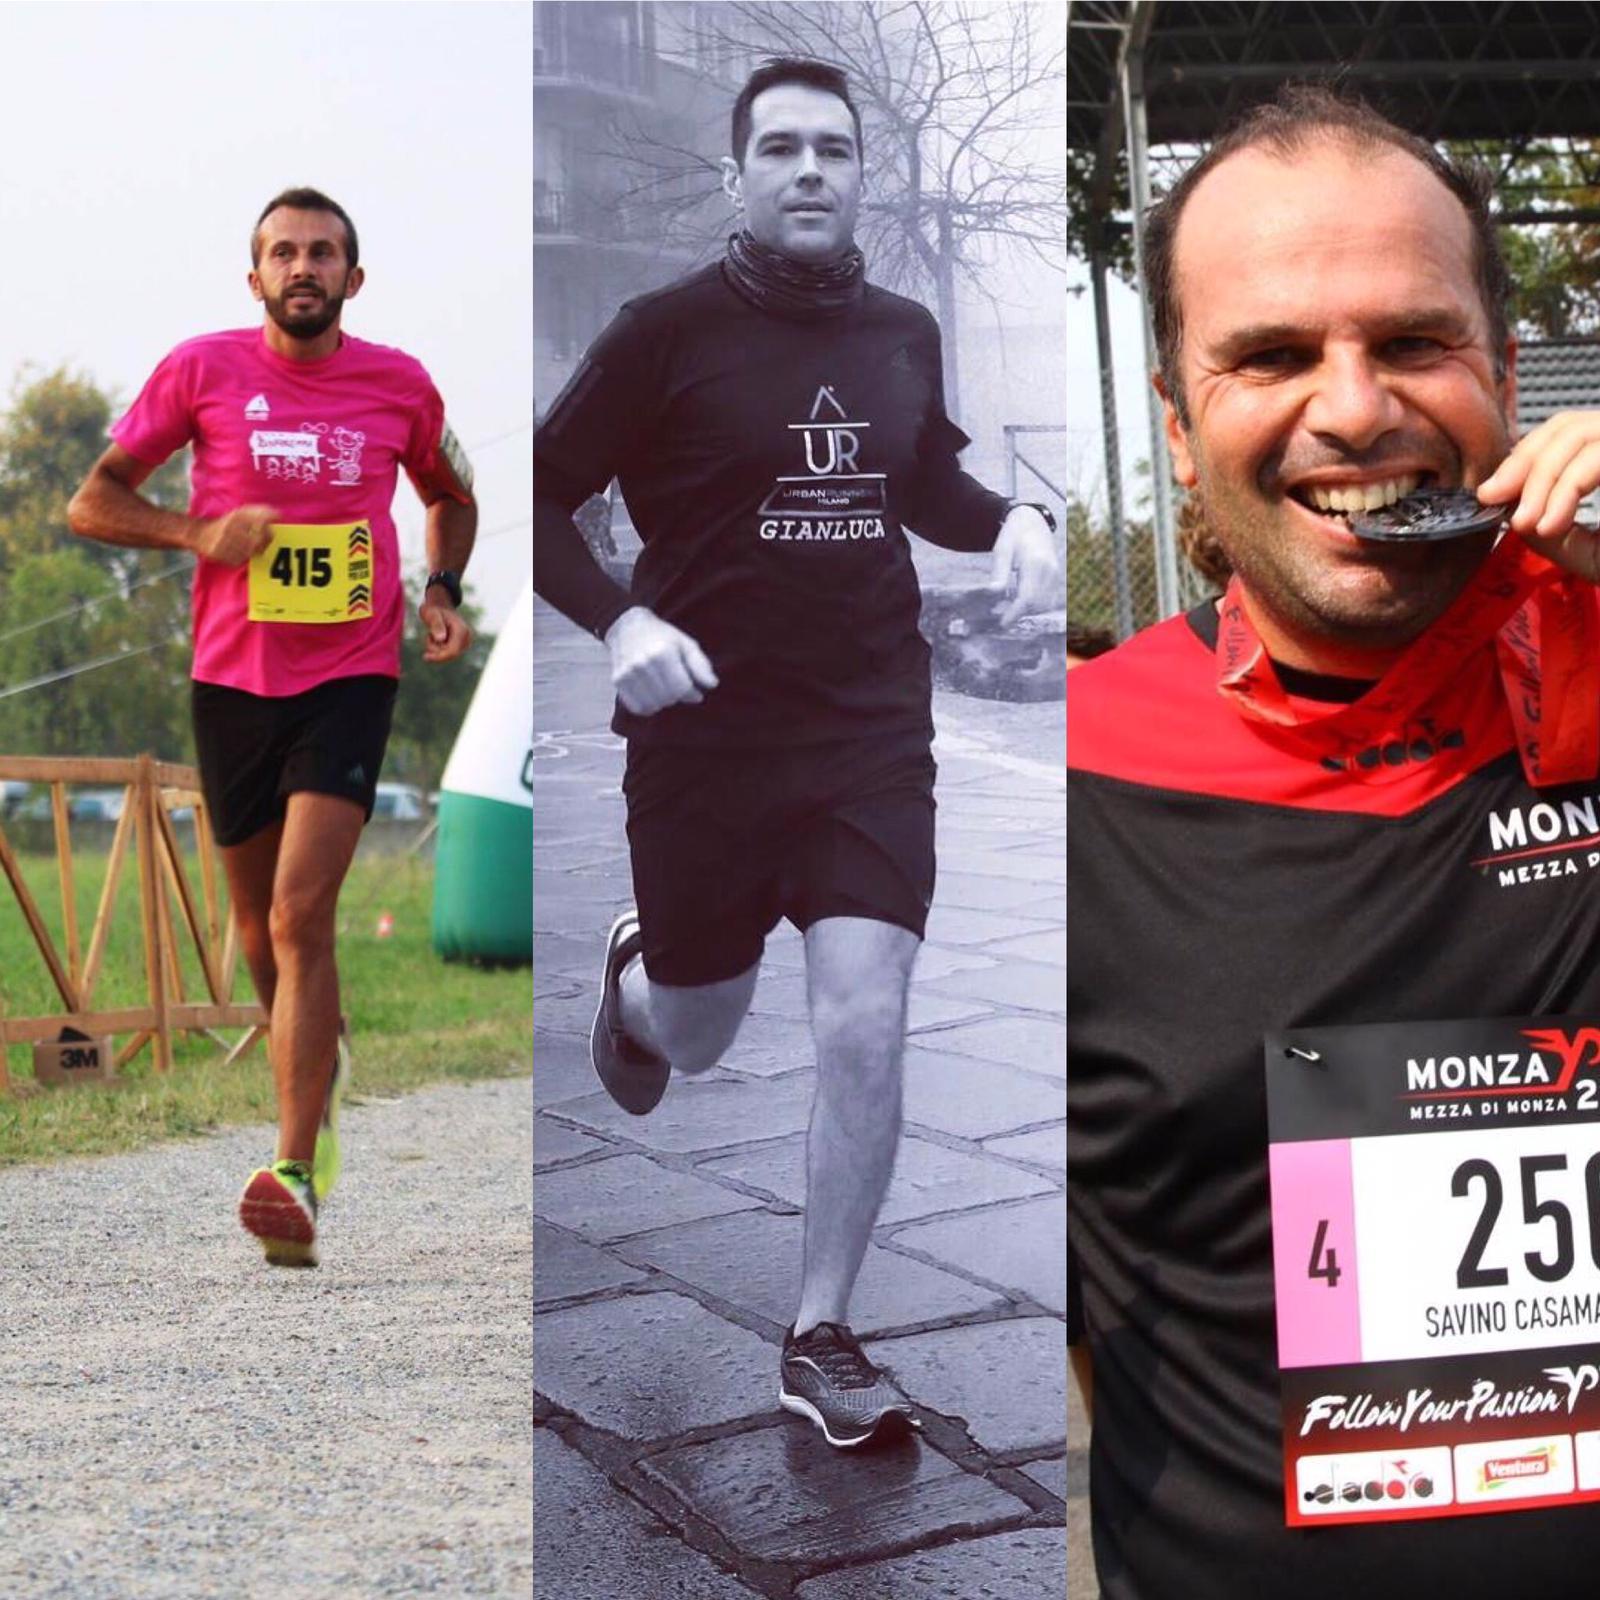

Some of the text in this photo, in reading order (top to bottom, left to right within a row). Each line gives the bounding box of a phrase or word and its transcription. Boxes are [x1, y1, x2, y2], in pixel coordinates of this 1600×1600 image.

[804, 429, 860, 474] UR
[759, 518, 885, 541] GIANLUCA
[270, 547, 332, 587] 415
[1489, 796, 1600, 851] MON
[1498, 857, 1578, 887] MEZZA
[60, 1046, 99, 1070] 3M
[1406, 1052, 1550, 1091] MONZA
[1410, 1103, 1473, 1120] MEZZA
[1481, 1102, 1499, 1115] DI
[1507, 1098, 1567, 1114] MONZA
[1308, 1219, 1341, 1288] 4
[1425, 1301, 1507, 1338] SAVINO
